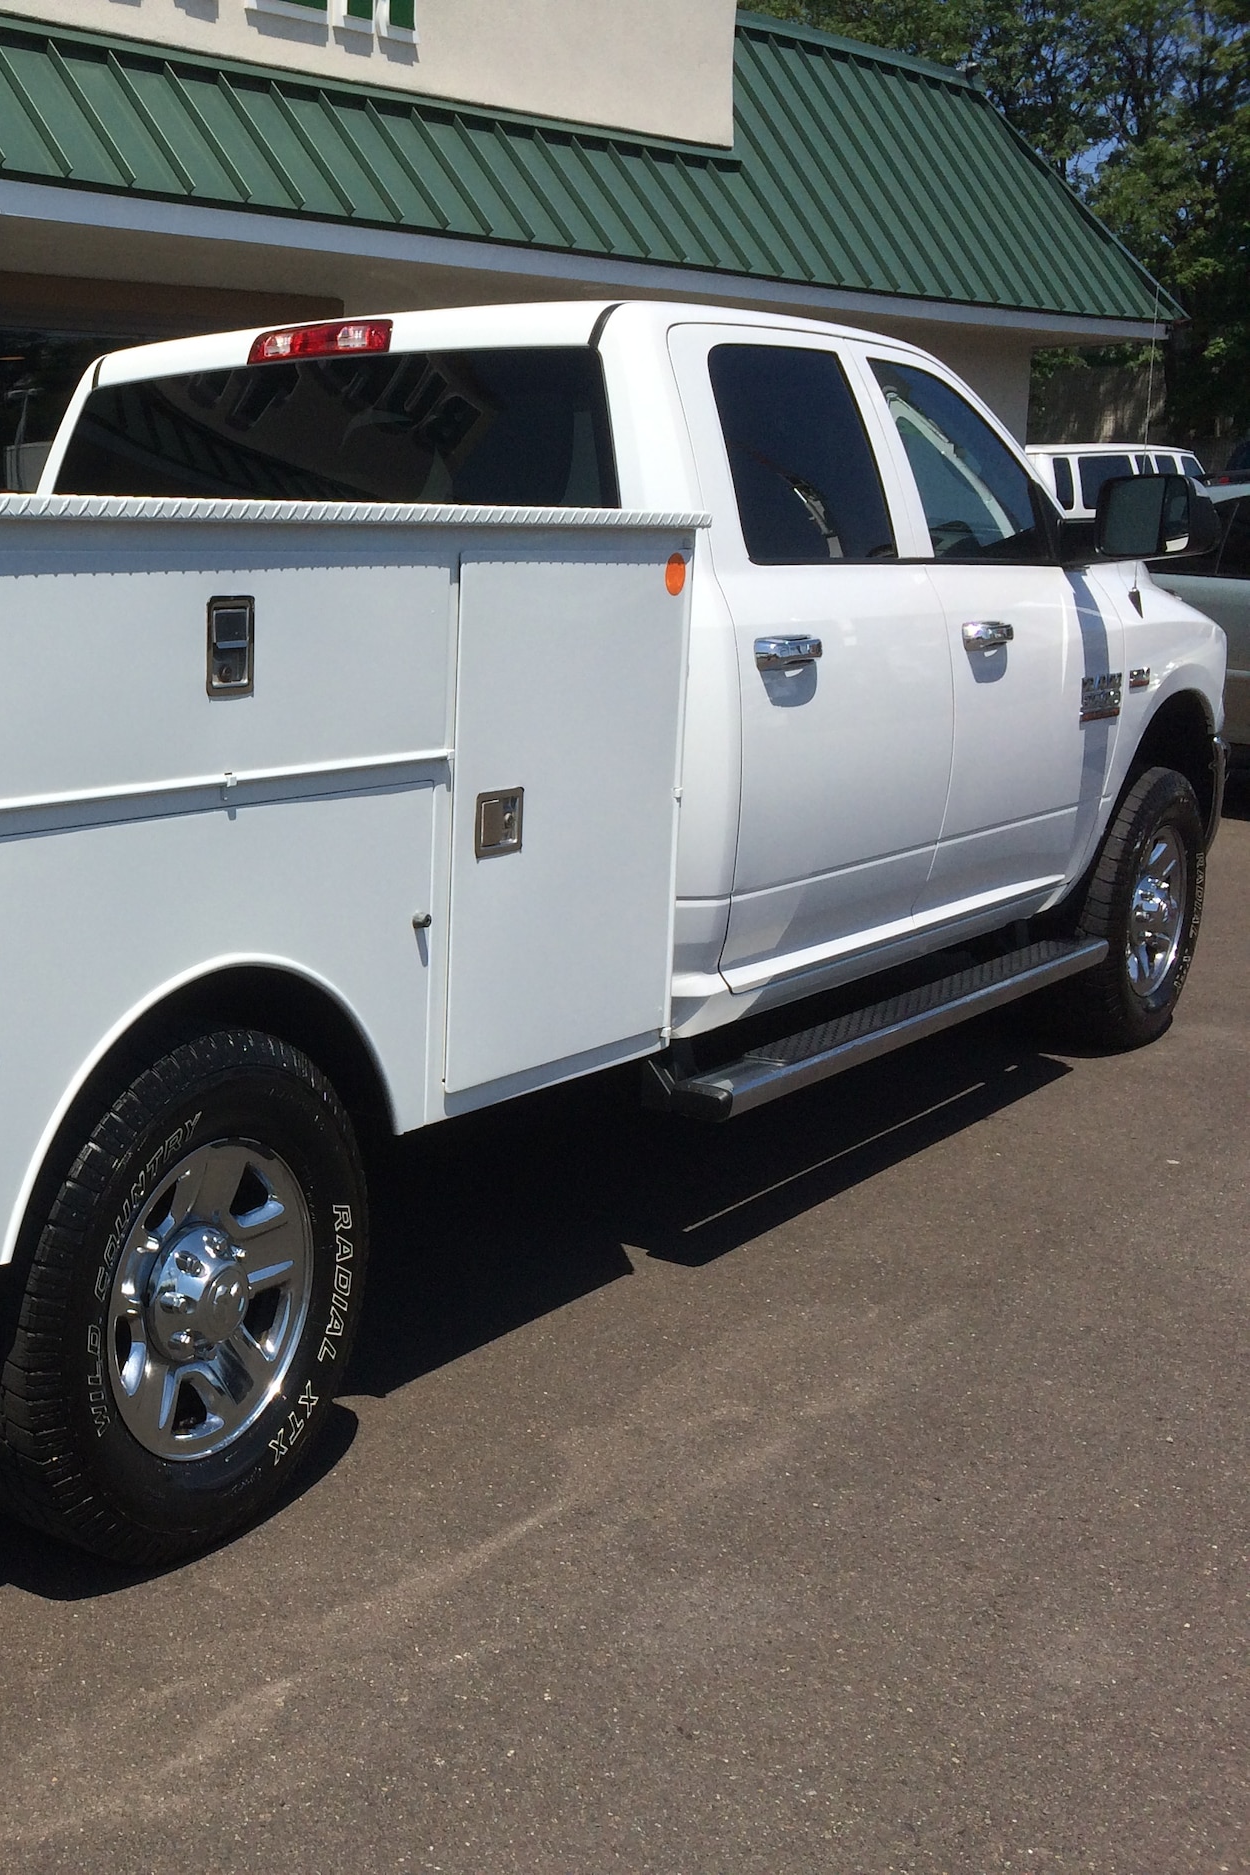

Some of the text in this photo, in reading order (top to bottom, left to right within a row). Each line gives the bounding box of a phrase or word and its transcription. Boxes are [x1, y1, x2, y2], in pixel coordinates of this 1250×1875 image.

[87, 1110, 203, 1438] WILD COUNTRY
[267, 1203, 354, 1467] RADIAL XTX
